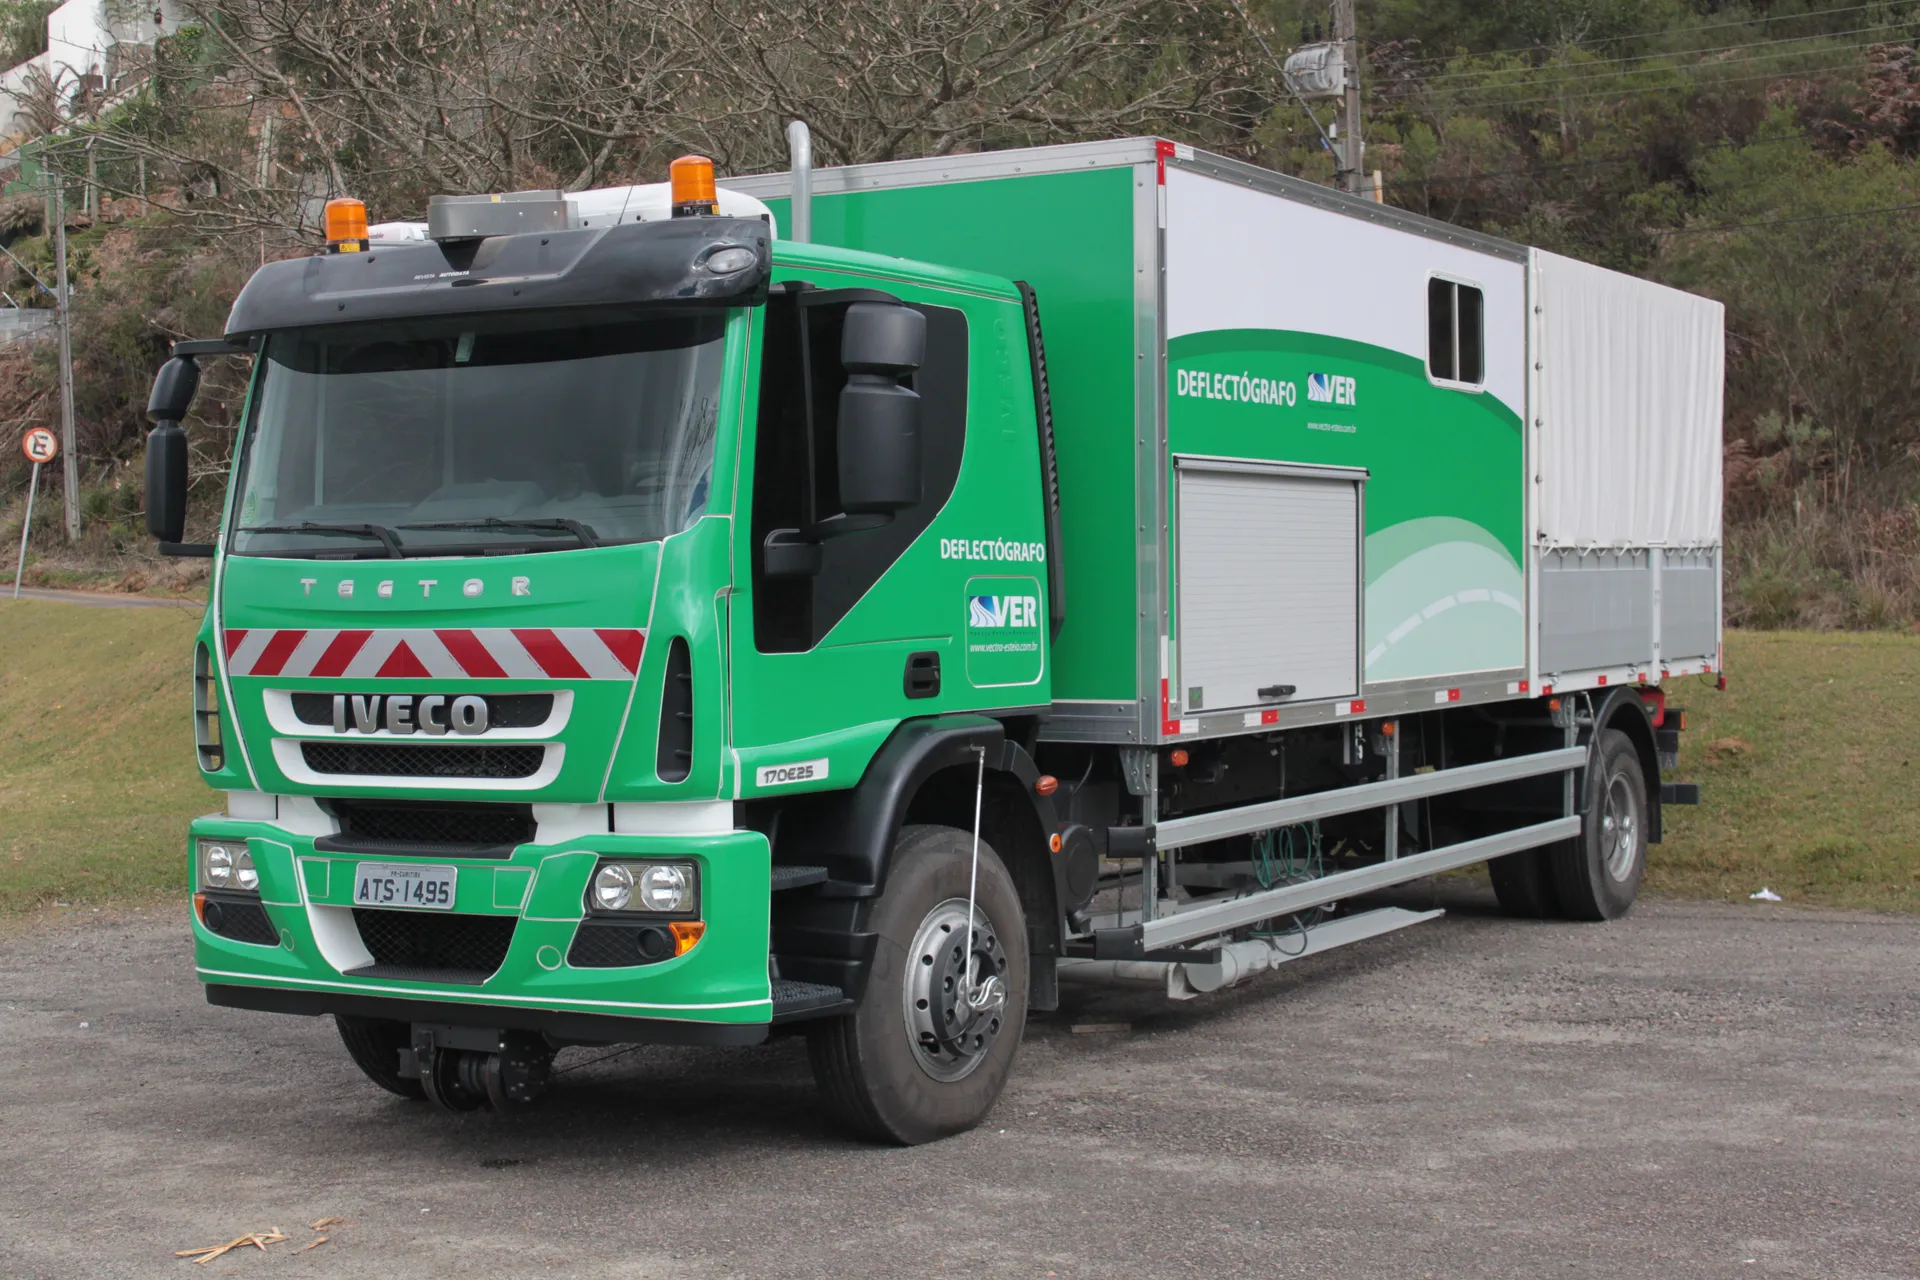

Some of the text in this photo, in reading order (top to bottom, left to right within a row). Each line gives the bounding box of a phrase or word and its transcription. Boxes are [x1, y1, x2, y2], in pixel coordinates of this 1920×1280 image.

[439, 270, 470, 278] AUTODATA
[1177, 369, 1297, 407] DEFLECTÓGRAFO
[1323, 373, 1356, 406] VER
[940, 536, 1045, 563] DEFLECTÓGRAFO
[300, 576, 531, 599] TECTOR
[991, 595, 1037, 627] VER
[333, 695, 488, 735] IVECO
[763, 765, 814, 784] 170E25
